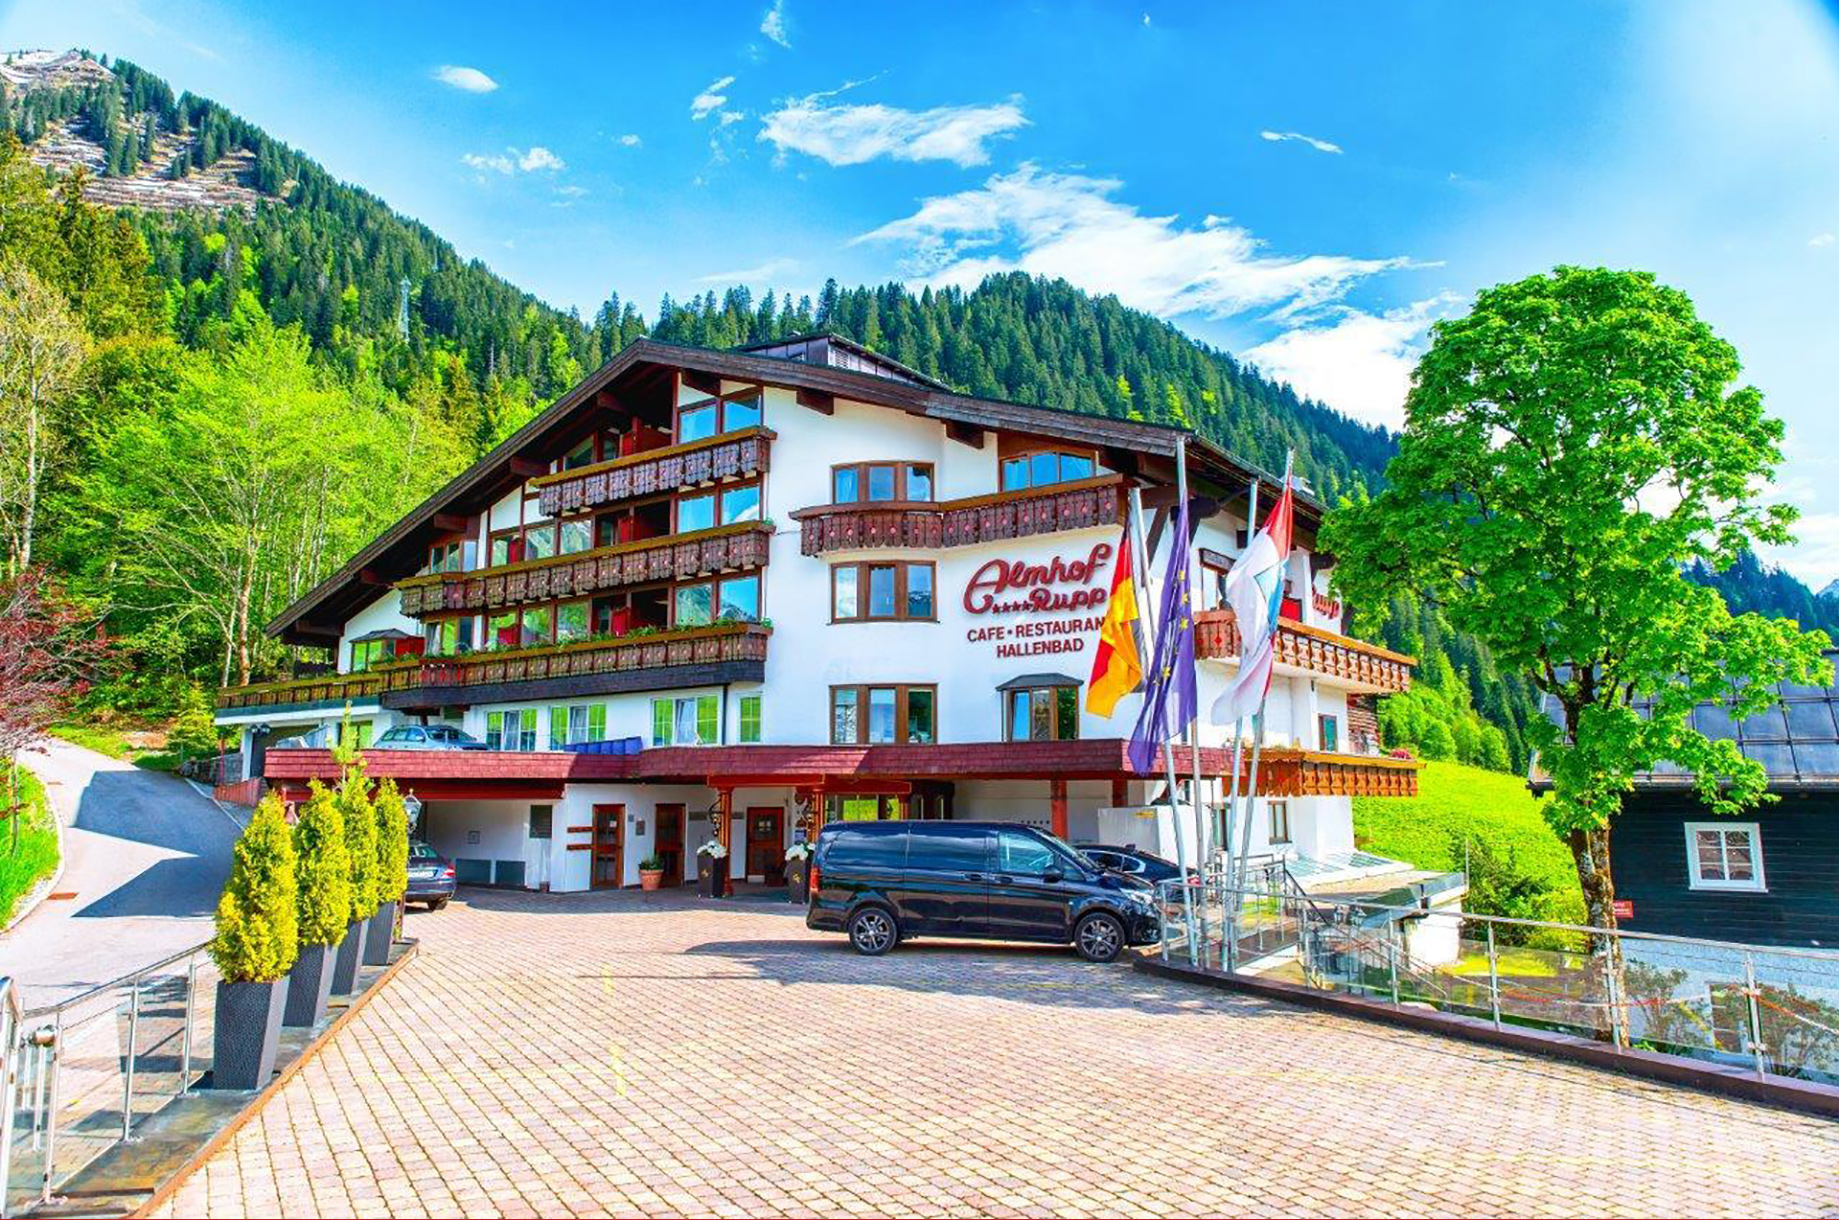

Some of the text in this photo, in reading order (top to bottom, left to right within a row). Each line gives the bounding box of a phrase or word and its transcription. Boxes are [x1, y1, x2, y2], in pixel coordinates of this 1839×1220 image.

[963, 543, 1112, 614] Almhof
[1029, 588, 1107, 612] Rupp
[967, 617, 1105, 642] CAFE RESTAURAN
[996, 638, 1084, 658] HALLENBAD
